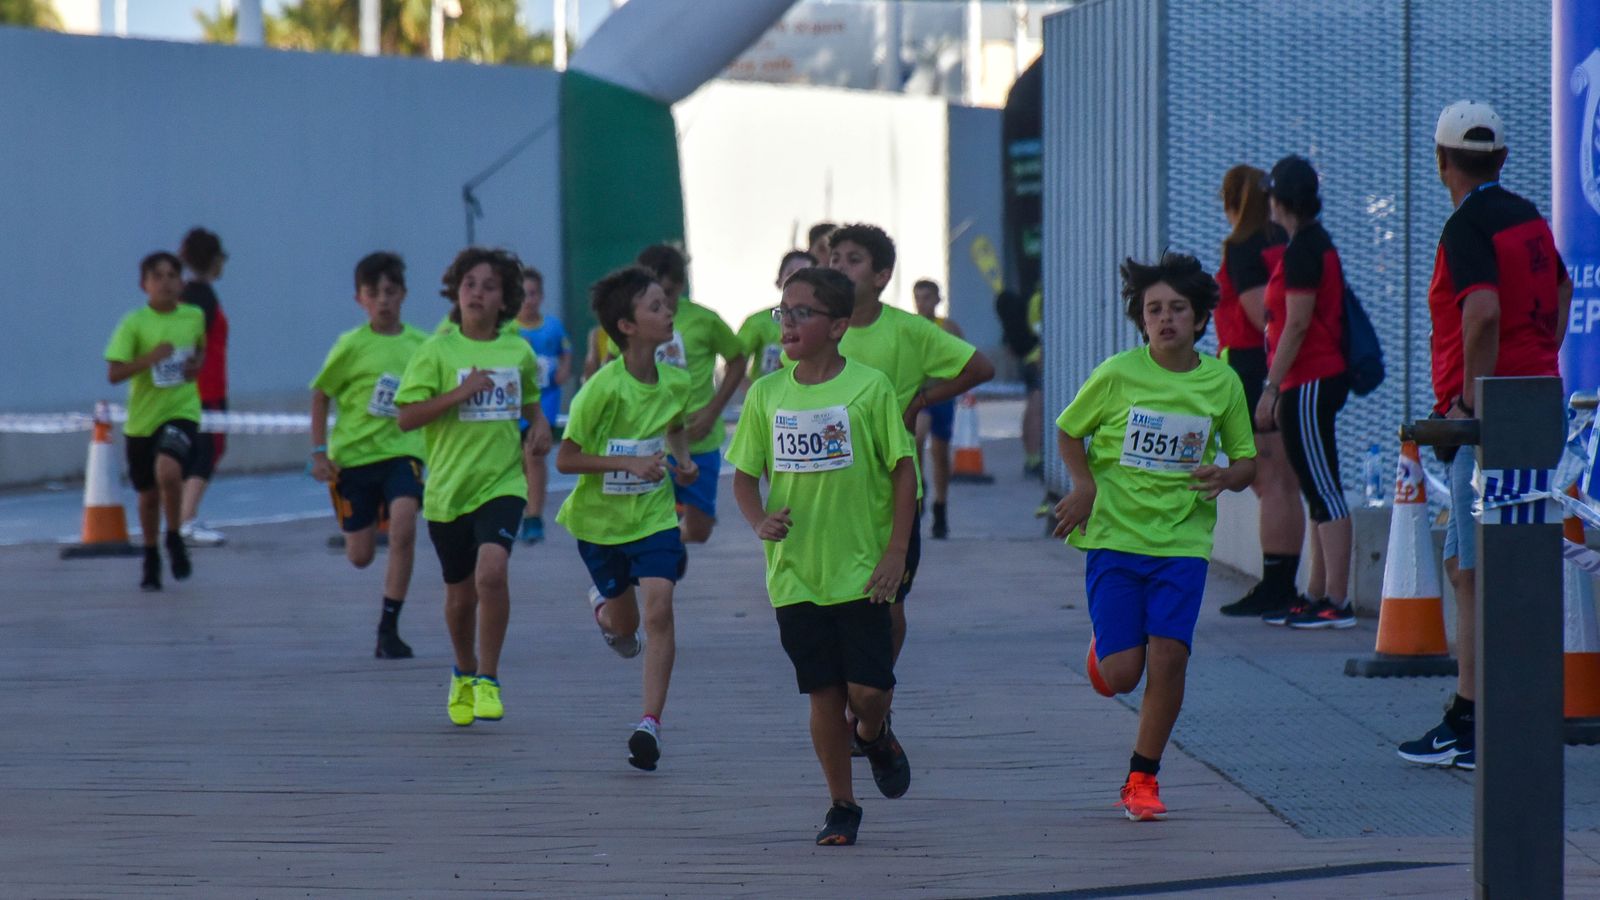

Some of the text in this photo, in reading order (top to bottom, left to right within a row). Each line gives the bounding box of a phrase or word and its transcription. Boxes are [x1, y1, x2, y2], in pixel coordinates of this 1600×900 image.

[1132, 413, 1148, 424] XXI
[777, 432, 823, 455] 1350
[1130, 430, 1179, 456] 1551
